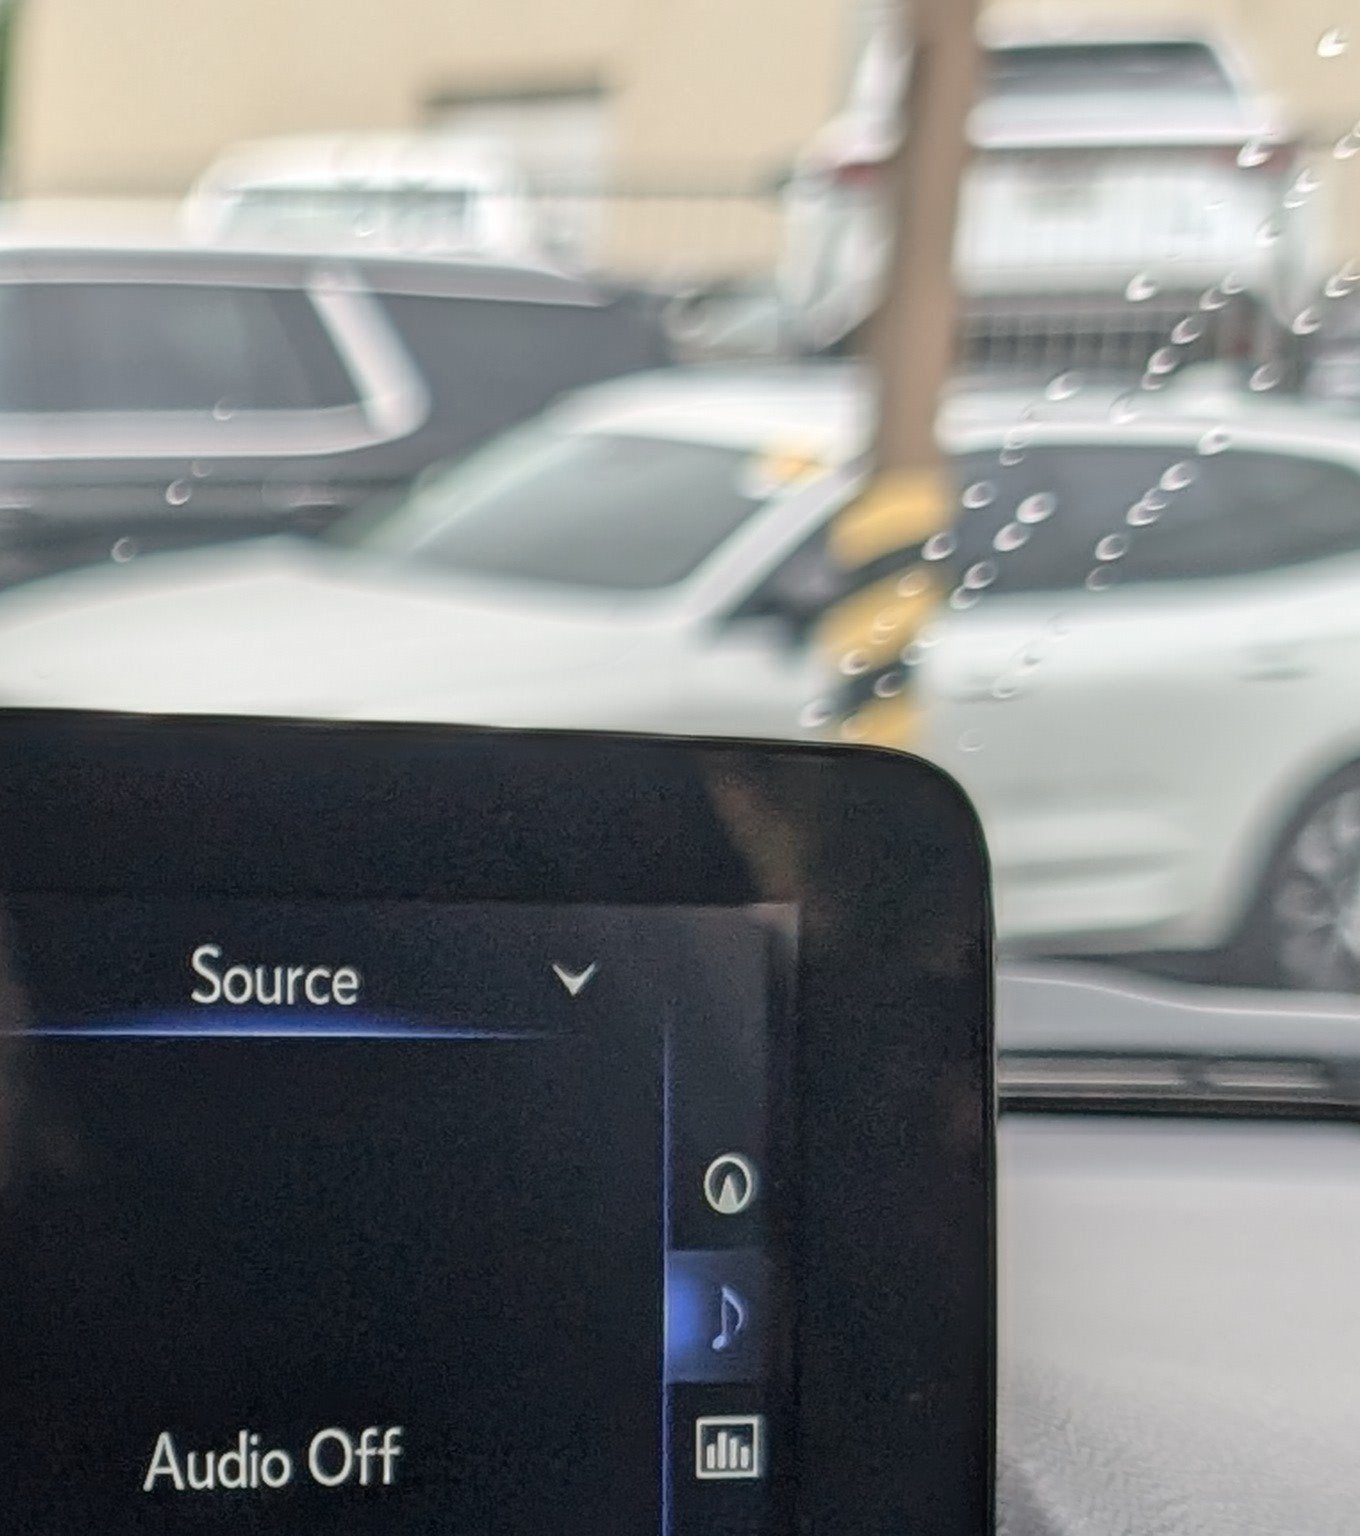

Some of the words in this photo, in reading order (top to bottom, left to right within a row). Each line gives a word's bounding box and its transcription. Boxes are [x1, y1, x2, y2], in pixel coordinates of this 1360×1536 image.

[190, 944, 360, 1006] Source
[143, 1431, 291, 1491] Audio
[308, 1425, 403, 1487] Off
